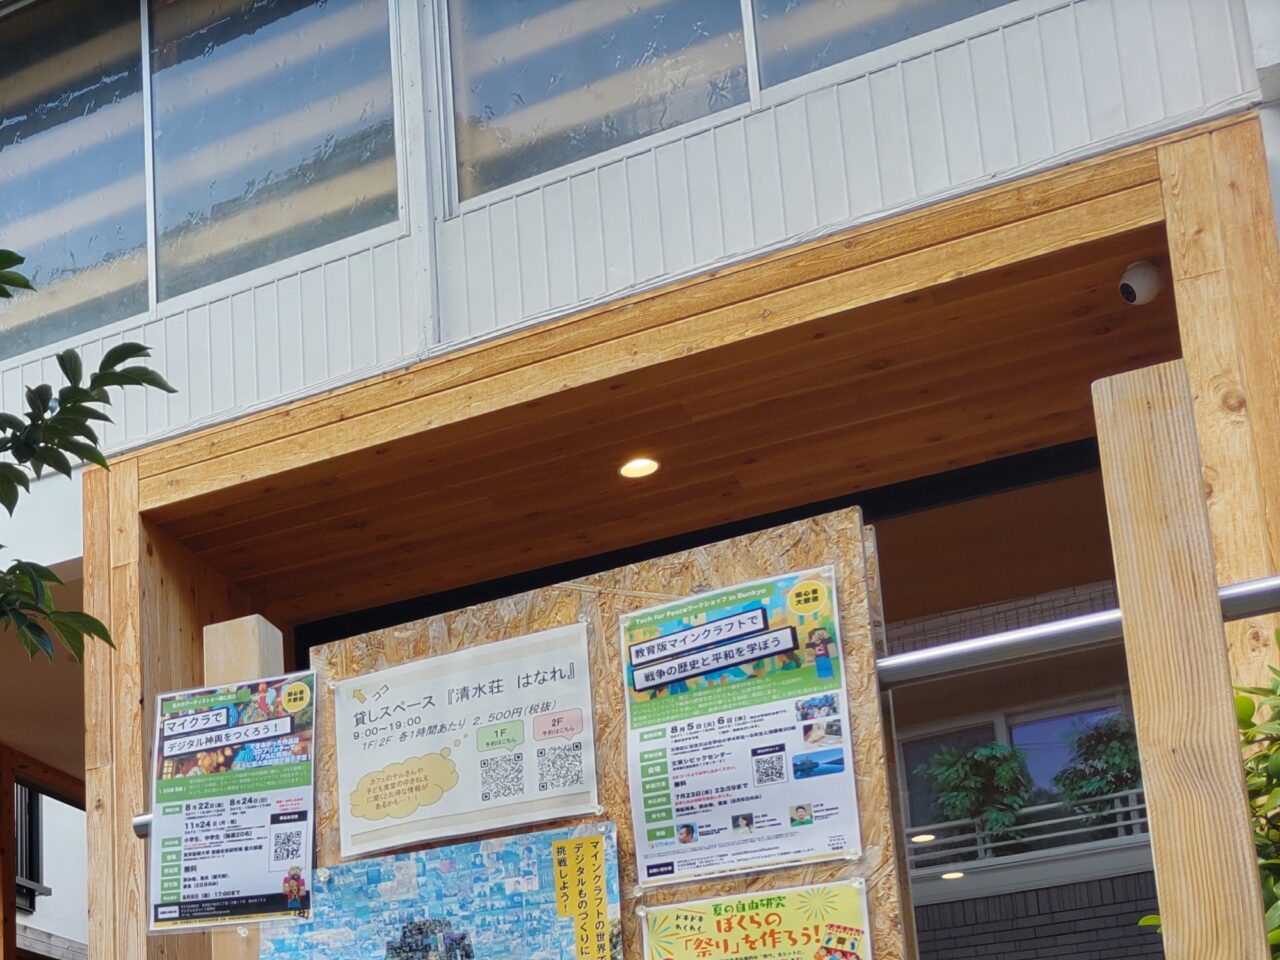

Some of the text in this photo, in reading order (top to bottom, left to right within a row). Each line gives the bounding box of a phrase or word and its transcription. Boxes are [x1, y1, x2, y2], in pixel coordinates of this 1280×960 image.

[634, 615, 759, 660] 教育版マインクラフトで
[643, 637, 782, 684] 戦争の歴史と平和を学ぼう
[353, 662, 576, 728] 貸しスペース 『清水荘 はなれ』
[166, 711, 223, 732] マイクラで
[551, 717, 564, 727] 2F
[494, 728, 506, 739] 1F
[556, 845, 570, 914] 挑戦しよう！
[574, 843, 590, 956] デジタルものづくりに
[712, 895, 786, 917] 夏の自由研究
[675, 912, 704, 922] ドキドキ
[716, 912, 782, 934] ぼくらの
